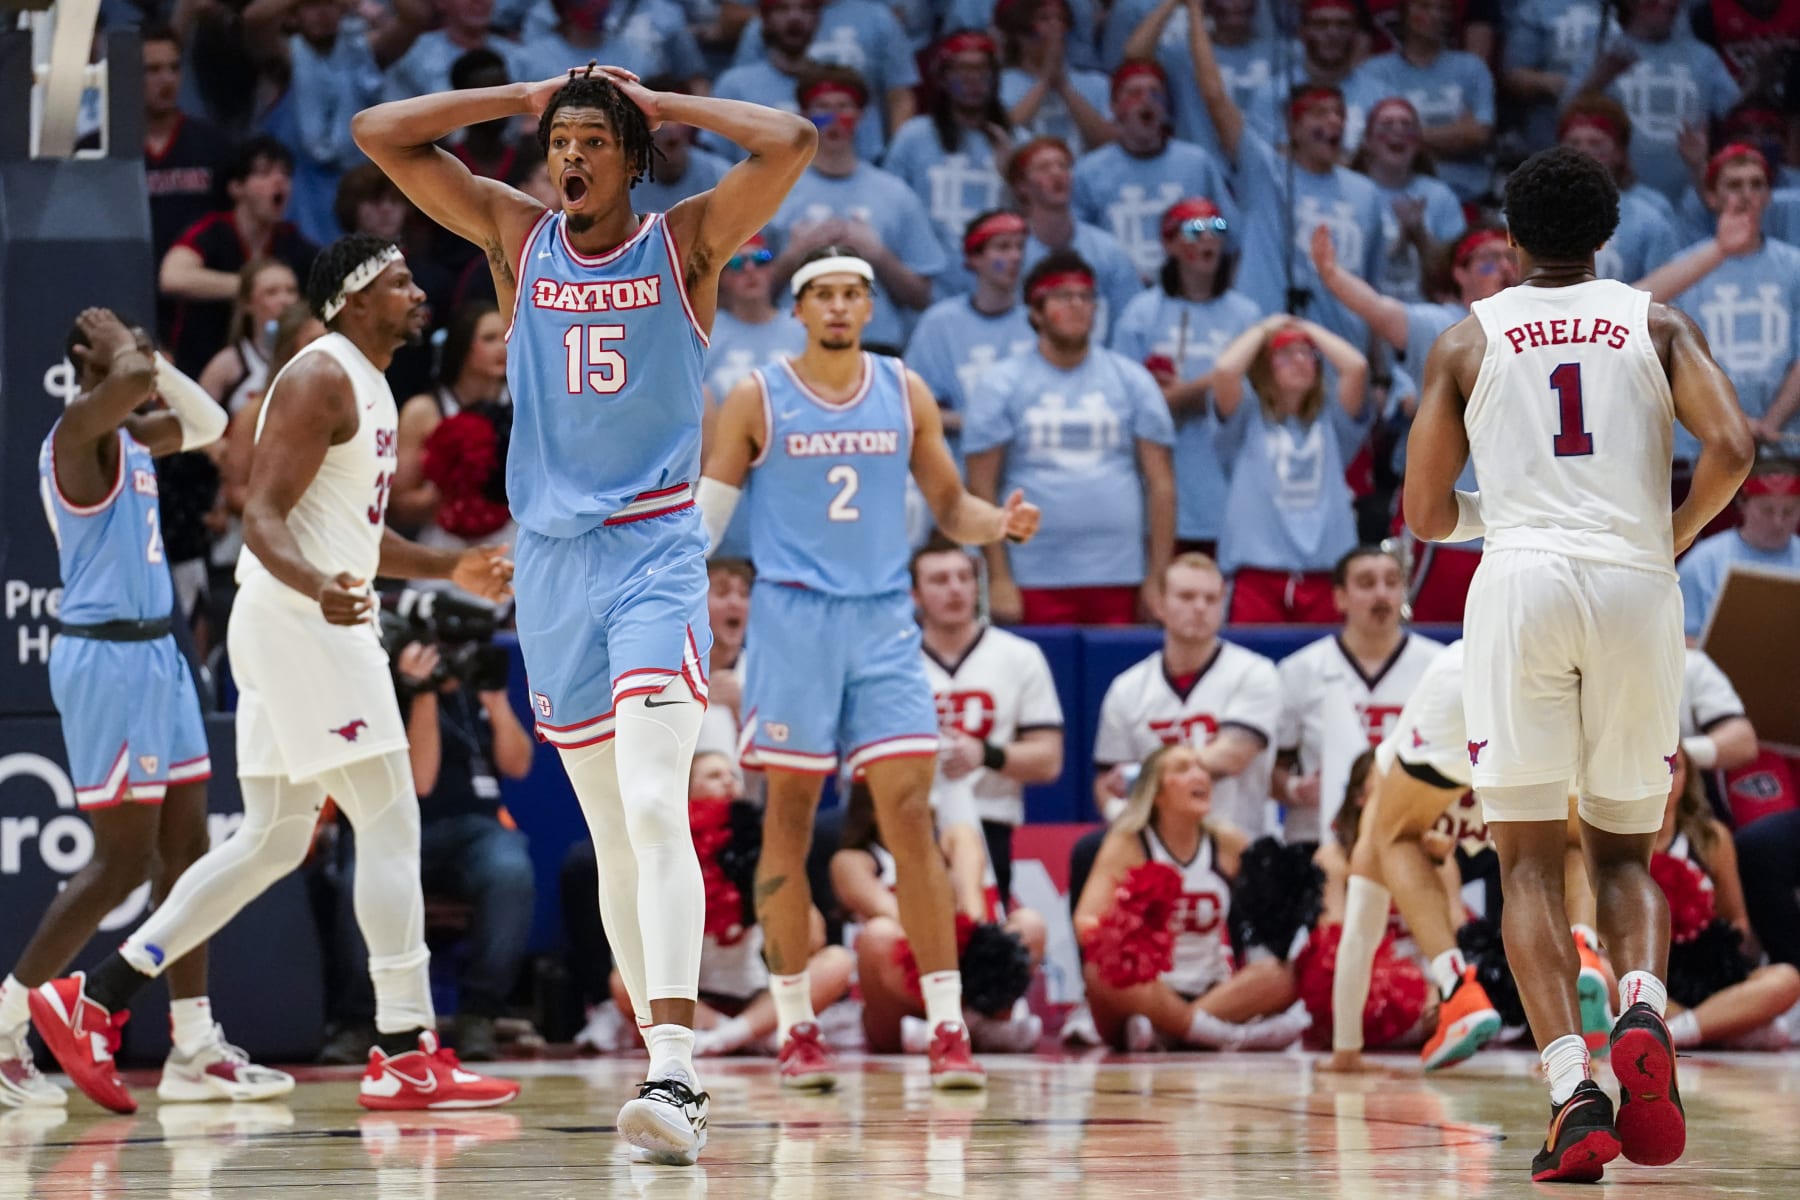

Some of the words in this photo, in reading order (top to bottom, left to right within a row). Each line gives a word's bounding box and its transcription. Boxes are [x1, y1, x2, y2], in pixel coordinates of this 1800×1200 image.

[532, 275, 661, 312] DAYTON
[1504, 318, 1630, 354] PHELPS
[564, 324, 628, 394] 15
[1549, 362, 1594, 457] 1
[376, 428, 398, 458] SM
[785, 429, 898, 457] DAYTON
[826, 464, 860, 522] 2
